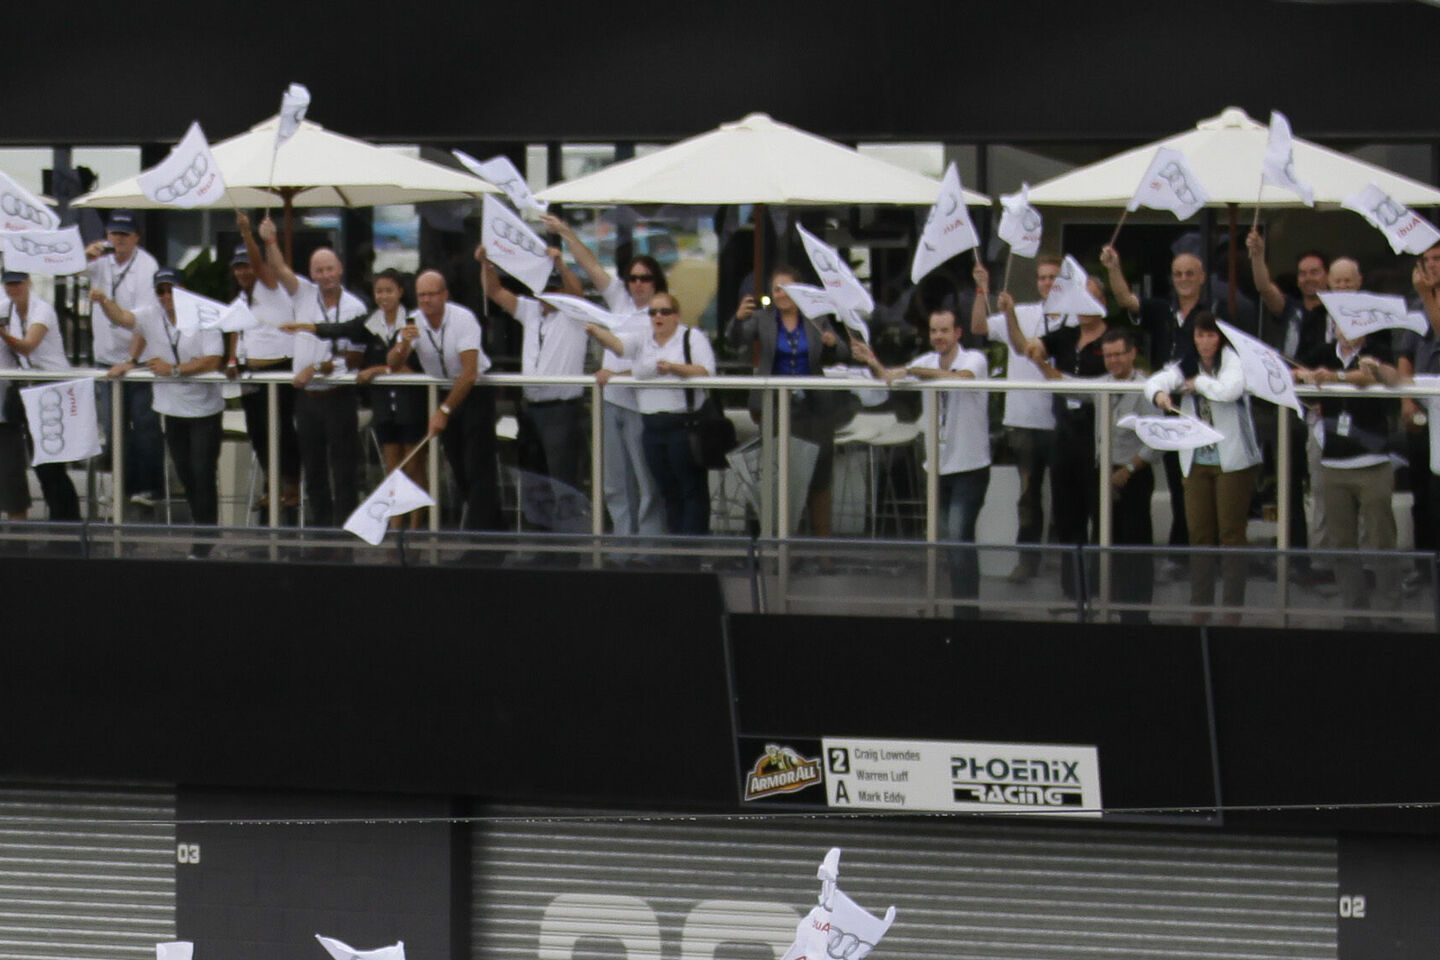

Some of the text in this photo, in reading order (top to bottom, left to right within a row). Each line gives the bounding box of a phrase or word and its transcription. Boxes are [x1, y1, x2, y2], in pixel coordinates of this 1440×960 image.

[831, 749, 846, 772] 2
[855, 749, 920, 762] Craig Lowndes
[856, 769, 908, 782] Warren Luff
[835, 780, 850, 803] A
[858, 791, 906, 805] Mark Eddy
[177, 843, 200, 864] 03
[1339, 896, 1366, 918] 02
